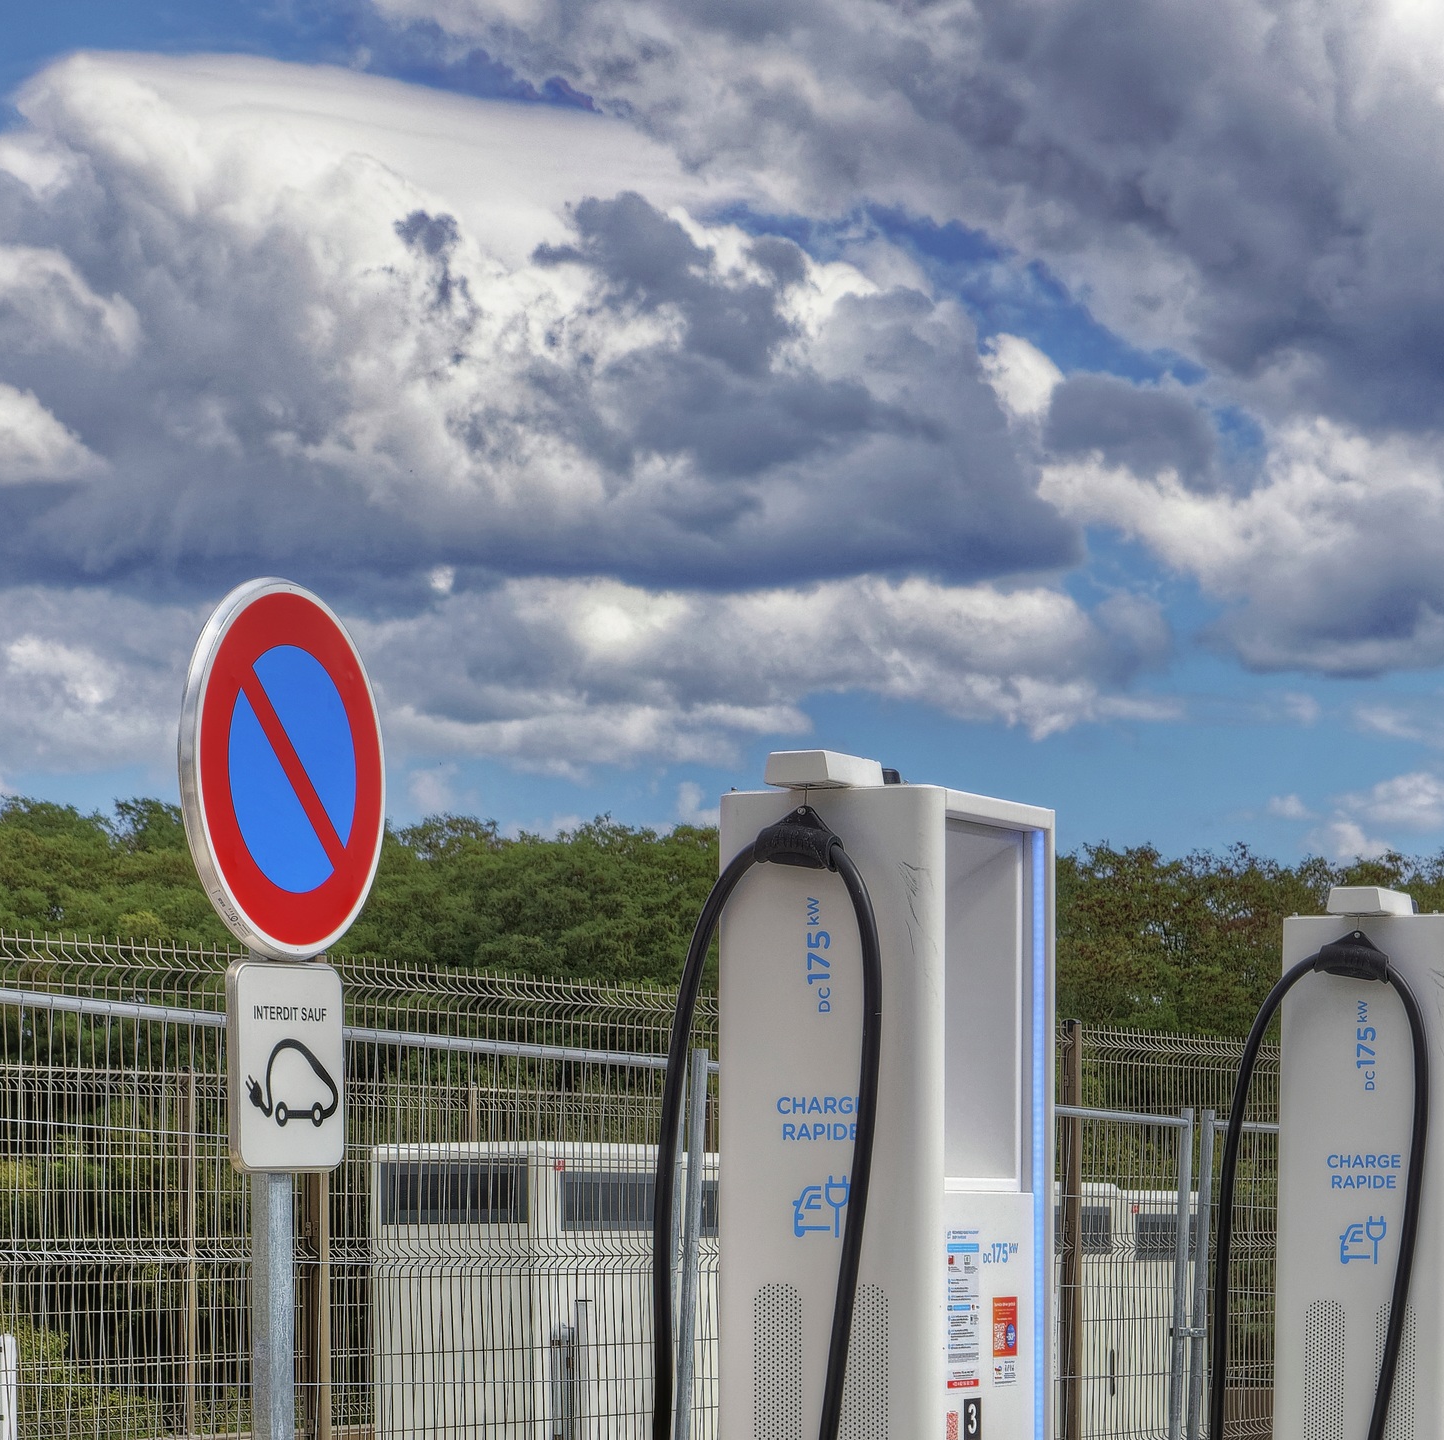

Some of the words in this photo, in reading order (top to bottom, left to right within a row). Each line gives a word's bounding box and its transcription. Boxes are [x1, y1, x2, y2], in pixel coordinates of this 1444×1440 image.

[253, 1005, 298, 1022] INTERDIT
[301, 1007, 327, 1022] SAUF
[782, 1123, 856, 1141] RAPIDE
[1327, 1154, 1401, 1169] CHARGE
[1331, 1175, 1397, 1189] RAPIDE
[967, 1403, 977, 1434] 3
